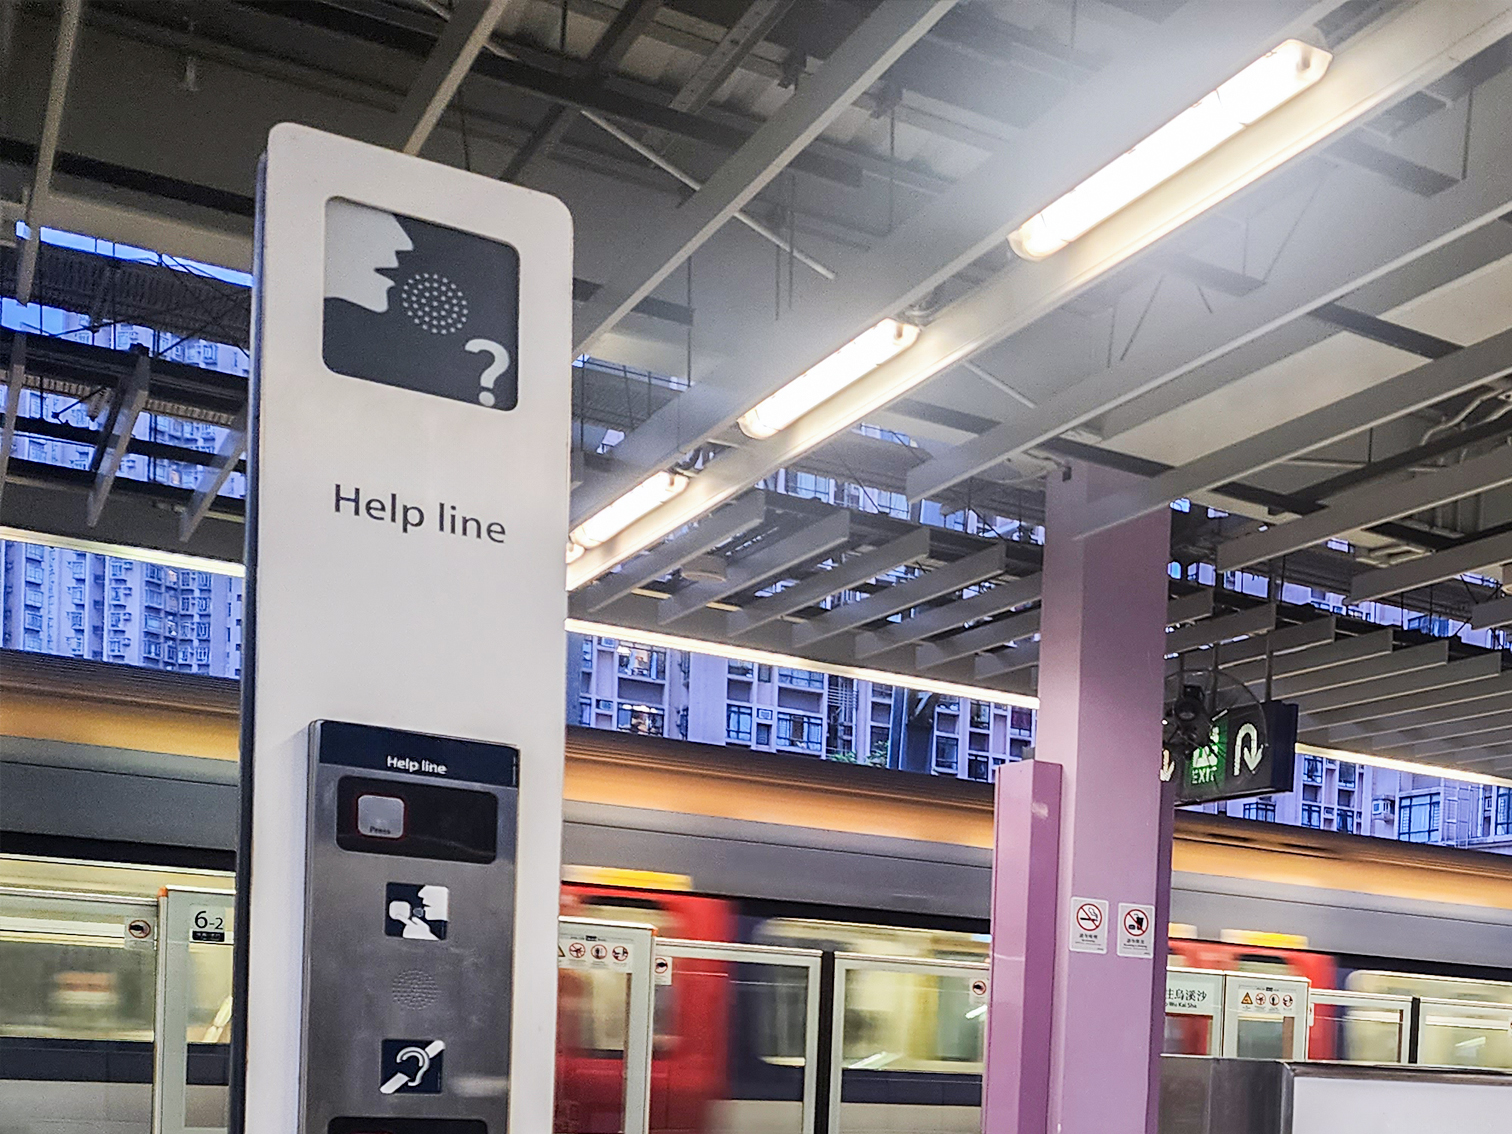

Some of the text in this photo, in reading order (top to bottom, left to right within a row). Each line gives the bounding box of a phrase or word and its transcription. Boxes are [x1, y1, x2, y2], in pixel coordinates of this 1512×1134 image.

[334, 483, 507, 544] Help line
[387, 755, 448, 775] Help line
[1191, 766, 1218, 784] EXIT
[194, 910, 224, 930] 6-2
